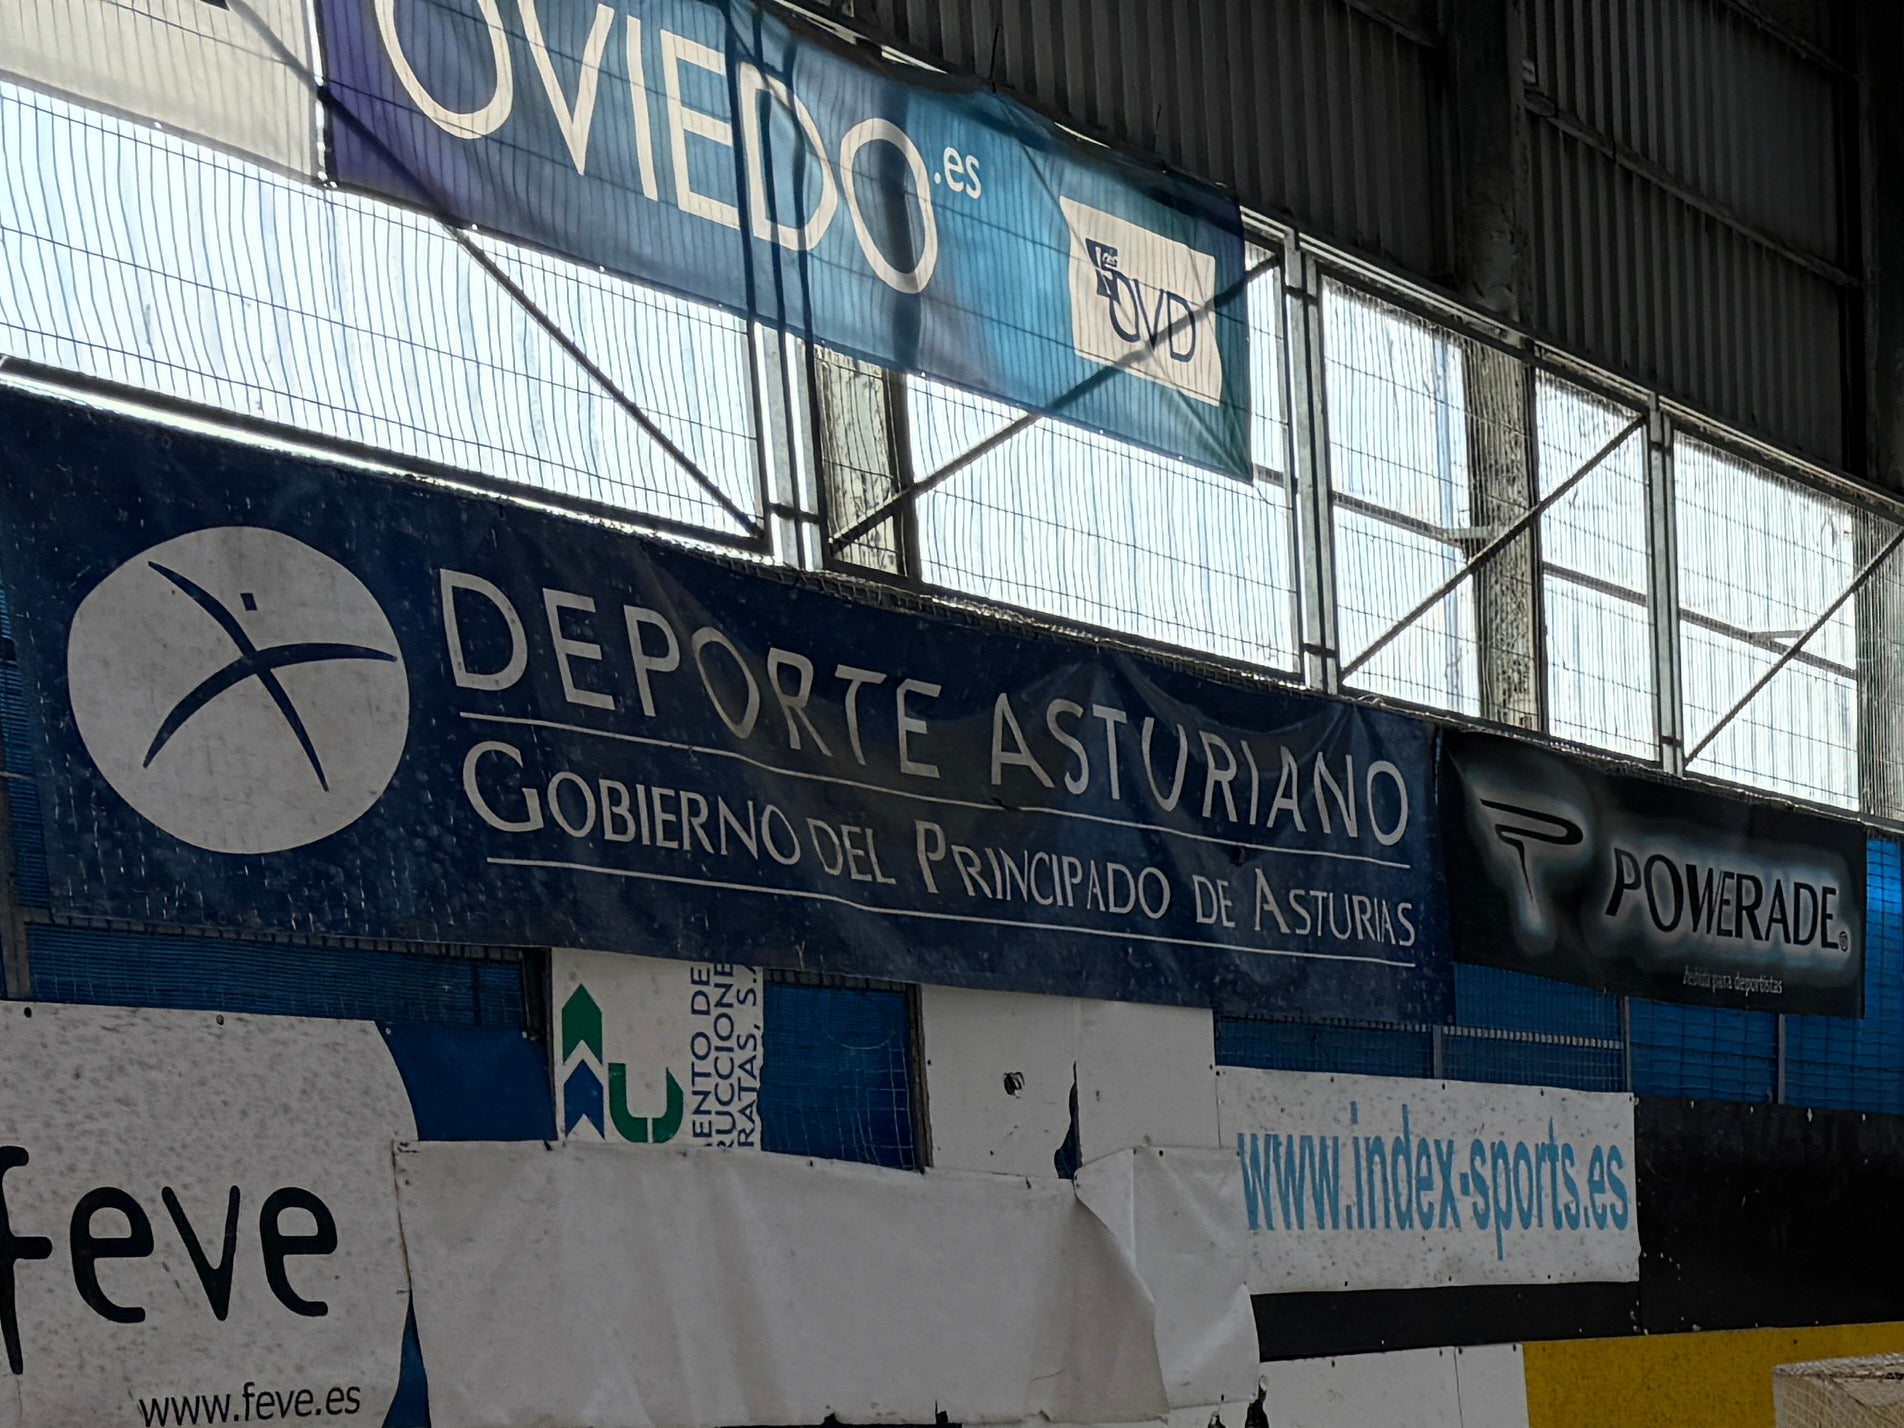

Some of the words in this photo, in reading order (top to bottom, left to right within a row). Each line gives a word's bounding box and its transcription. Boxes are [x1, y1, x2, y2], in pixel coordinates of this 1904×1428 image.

[440, 567, 943, 779] DEPORTE
[991, 692, 1410, 847] ASTURIANO
[462, 740, 801, 866] GOBIERNO
[806, 817, 897, 885] DEL
[914, 819, 1171, 920] PRINCIPADO
[1192, 874, 1236, 929] DE
[1253, 868, 1417, 948] ASTURIAS
[690, 966, 712, 1016] DE
[0, 1145, 338, 1375] feve
[1237, 1100, 1629, 1261] www.index-sports.es
[138, 1381, 361, 1428] www.feve.es
